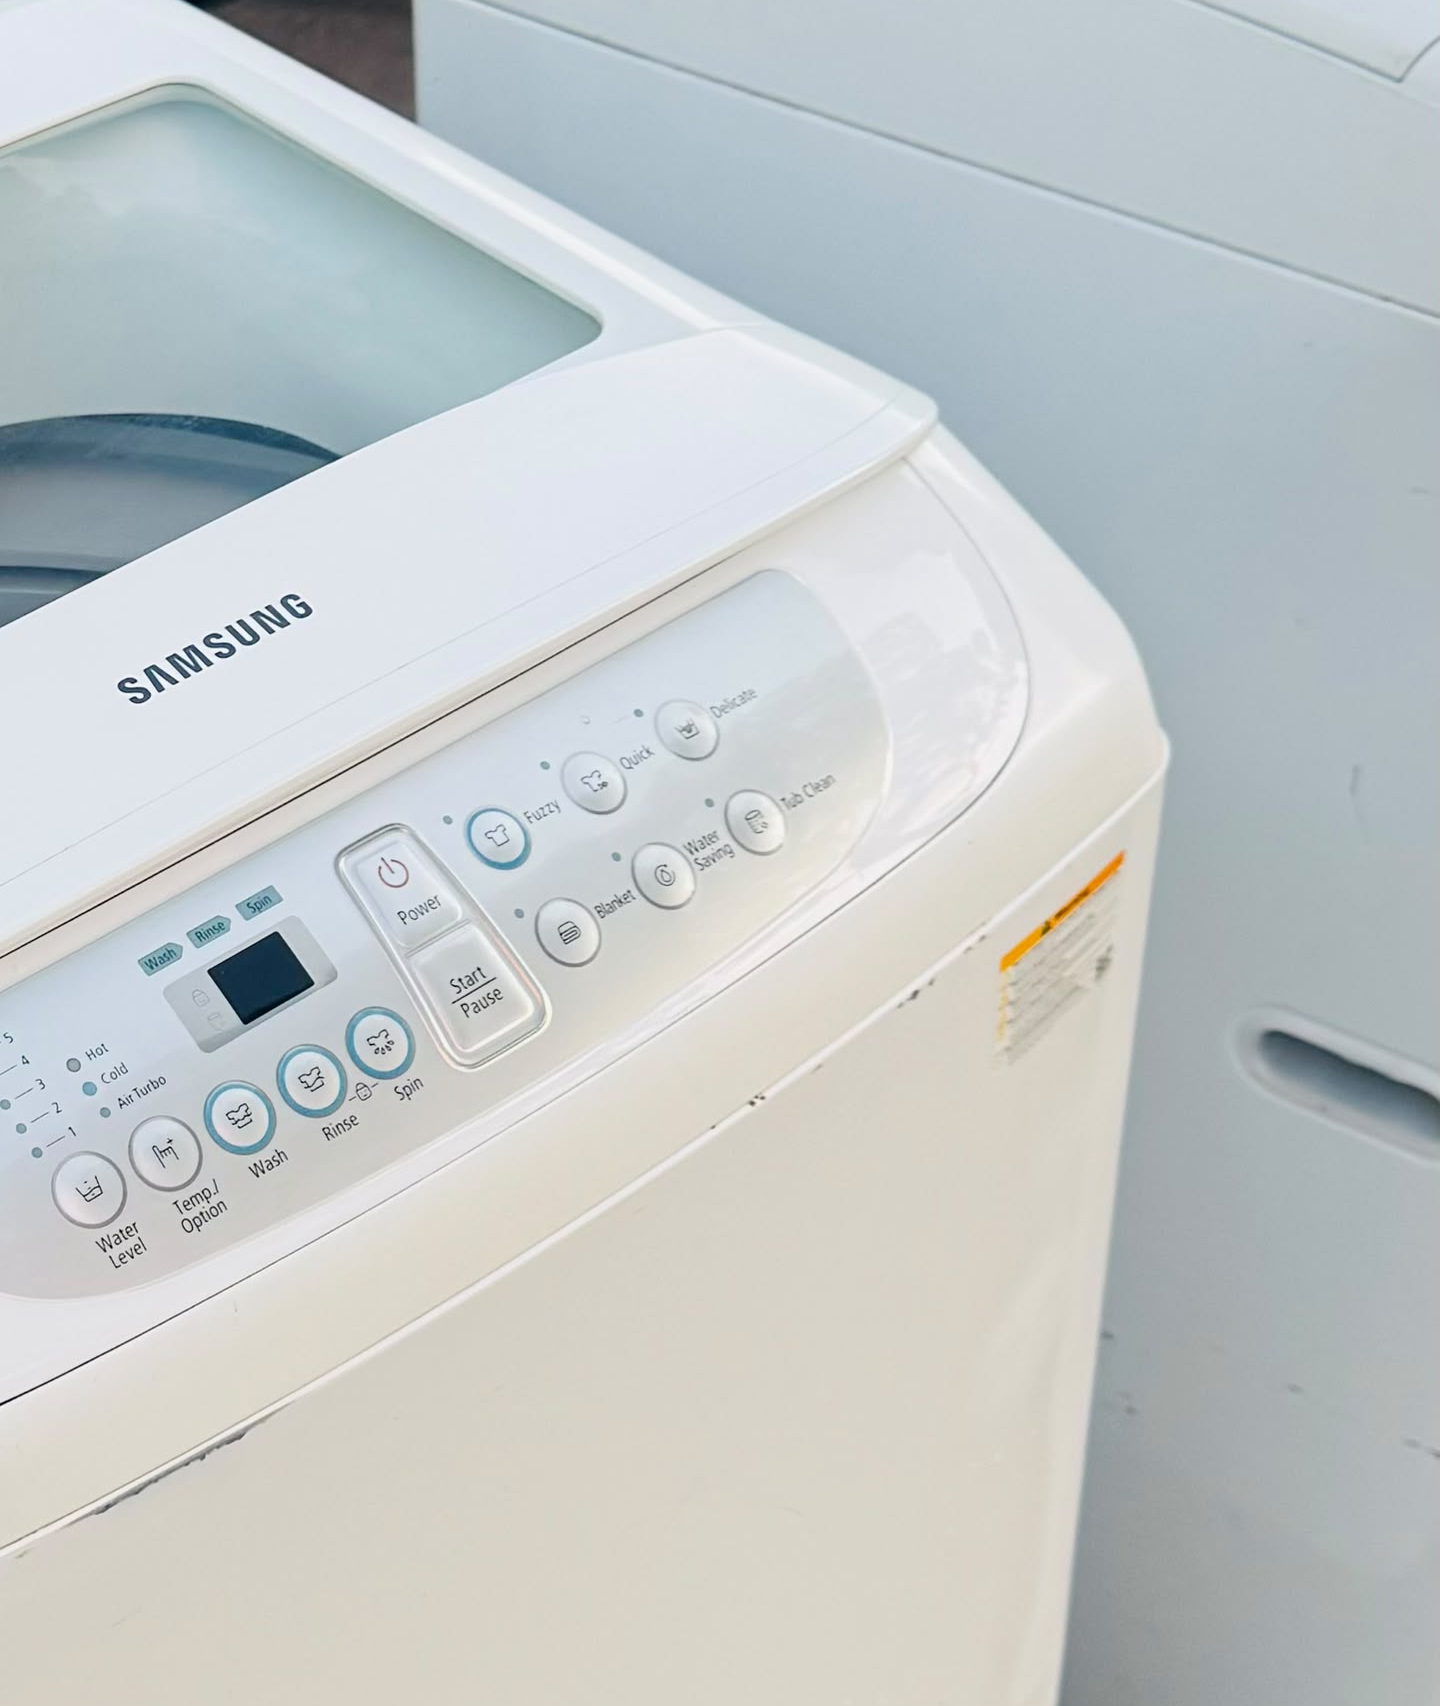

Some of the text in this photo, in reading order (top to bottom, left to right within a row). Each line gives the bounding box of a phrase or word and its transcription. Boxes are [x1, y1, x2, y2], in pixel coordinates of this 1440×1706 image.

[116, 592, 314, 705] SAMSUNG
[710, 688, 758, 719] Delicate
[619, 744, 656, 770] Quick
[780, 773, 837, 812] Tub Clean
[523, 798, 561, 825] Fuzzy
[682, 829, 720, 856] Water
[693, 843, 736, 872] Saving
[396, 894, 442, 925] Power
[593, 889, 636, 920] Blanket
[144, 894, 273, 971] Wash Rinse Spin
[449, 966, 488, 995] Start
[460, 988, 504, 1019] Pause
[2, 1031, 15, 1044] 5
[84, 1042, 111, 1061] Hot
[20, 1054, 31, 1066] 4
[100, 1061, 130, 1085] Cold
[34, 1078, 47, 1091] 3
[117, 1074, 168, 1110] Air Turbo
[393, 1077, 425, 1102] Spin
[51, 1101, 63, 1114] 2
[67, 1125, 78, 1137] 1
[321, 1114, 360, 1142] Rinse
[248, 1148, 289, 1179] Wash
[172, 1178, 221, 1215] Temp./
[180, 1200, 229, 1234] Option
[95, 1222, 140, 1254] Water
[108, 1236, 148, 1270] Level
